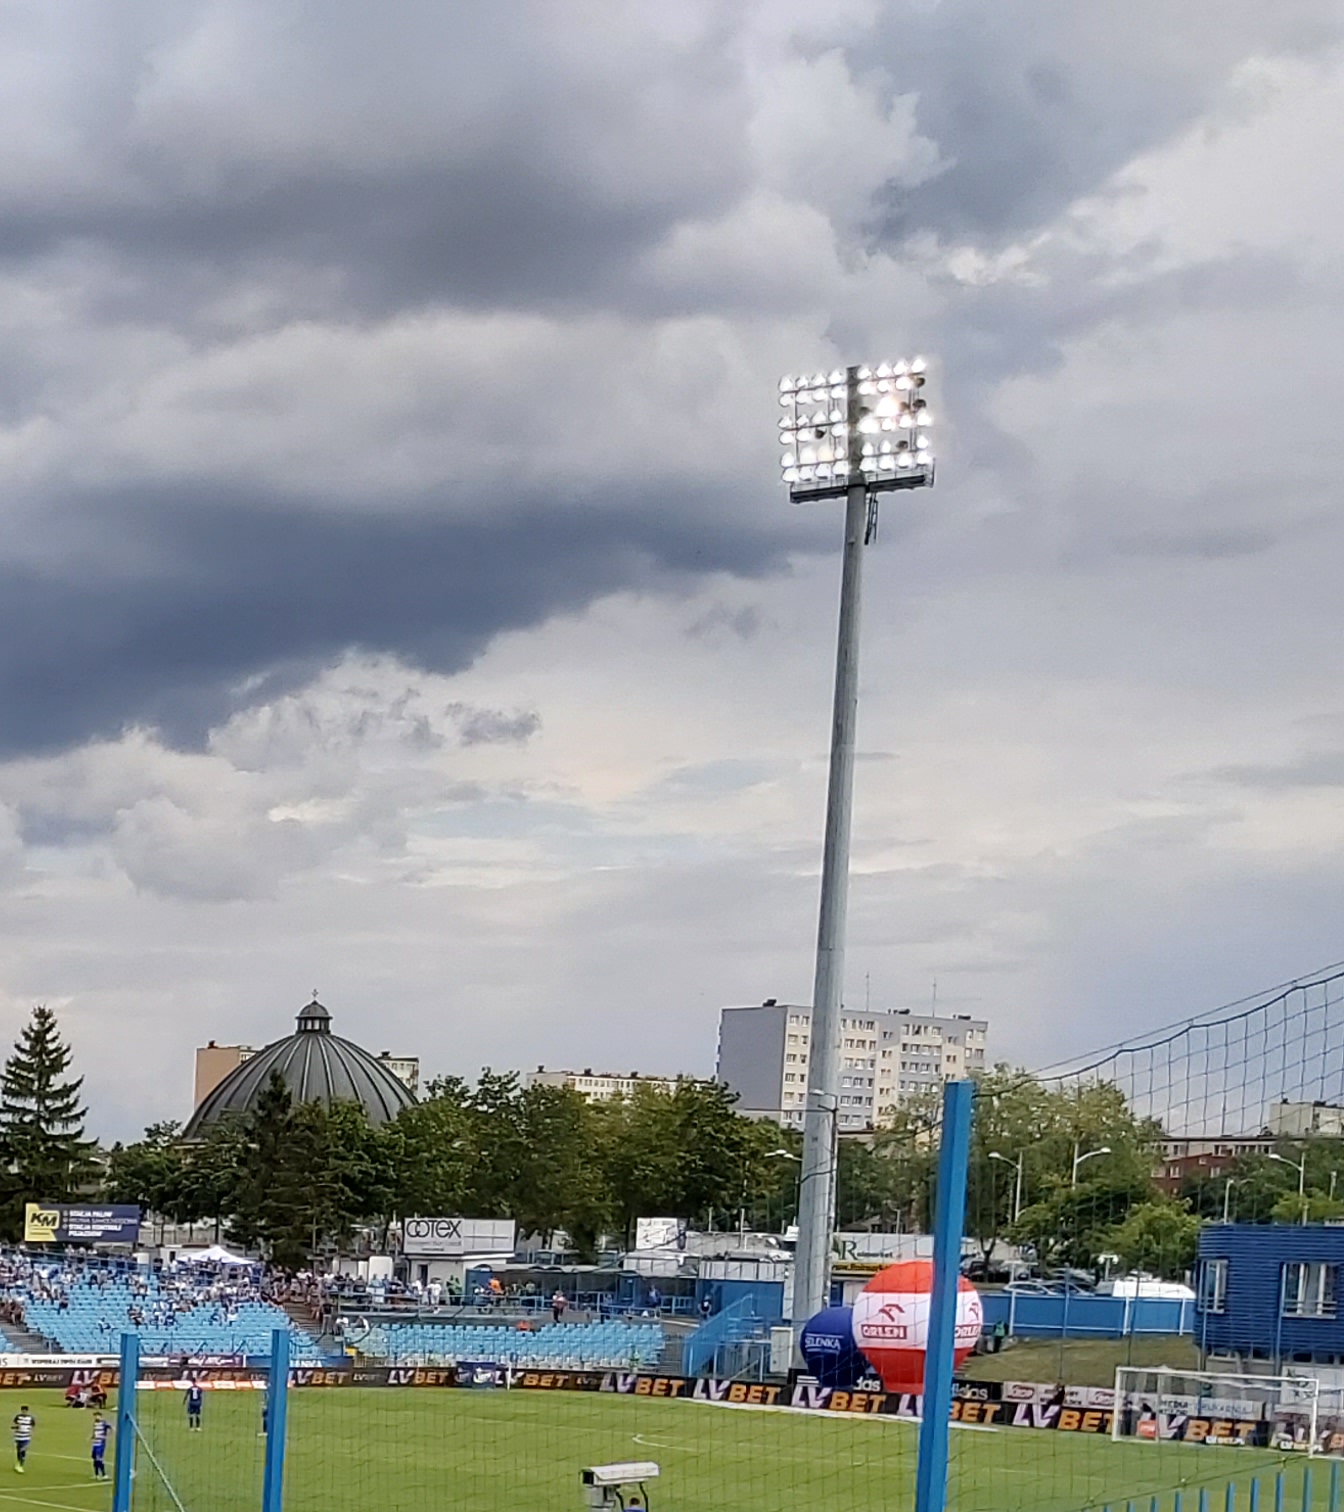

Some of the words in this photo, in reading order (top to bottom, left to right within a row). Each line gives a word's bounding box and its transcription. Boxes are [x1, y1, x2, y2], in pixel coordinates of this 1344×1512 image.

[599, 1373, 686, 1397] LVBET
[693, 1378, 782, 1405] LVBET
[791, 1386, 886, 1413] LVBET
